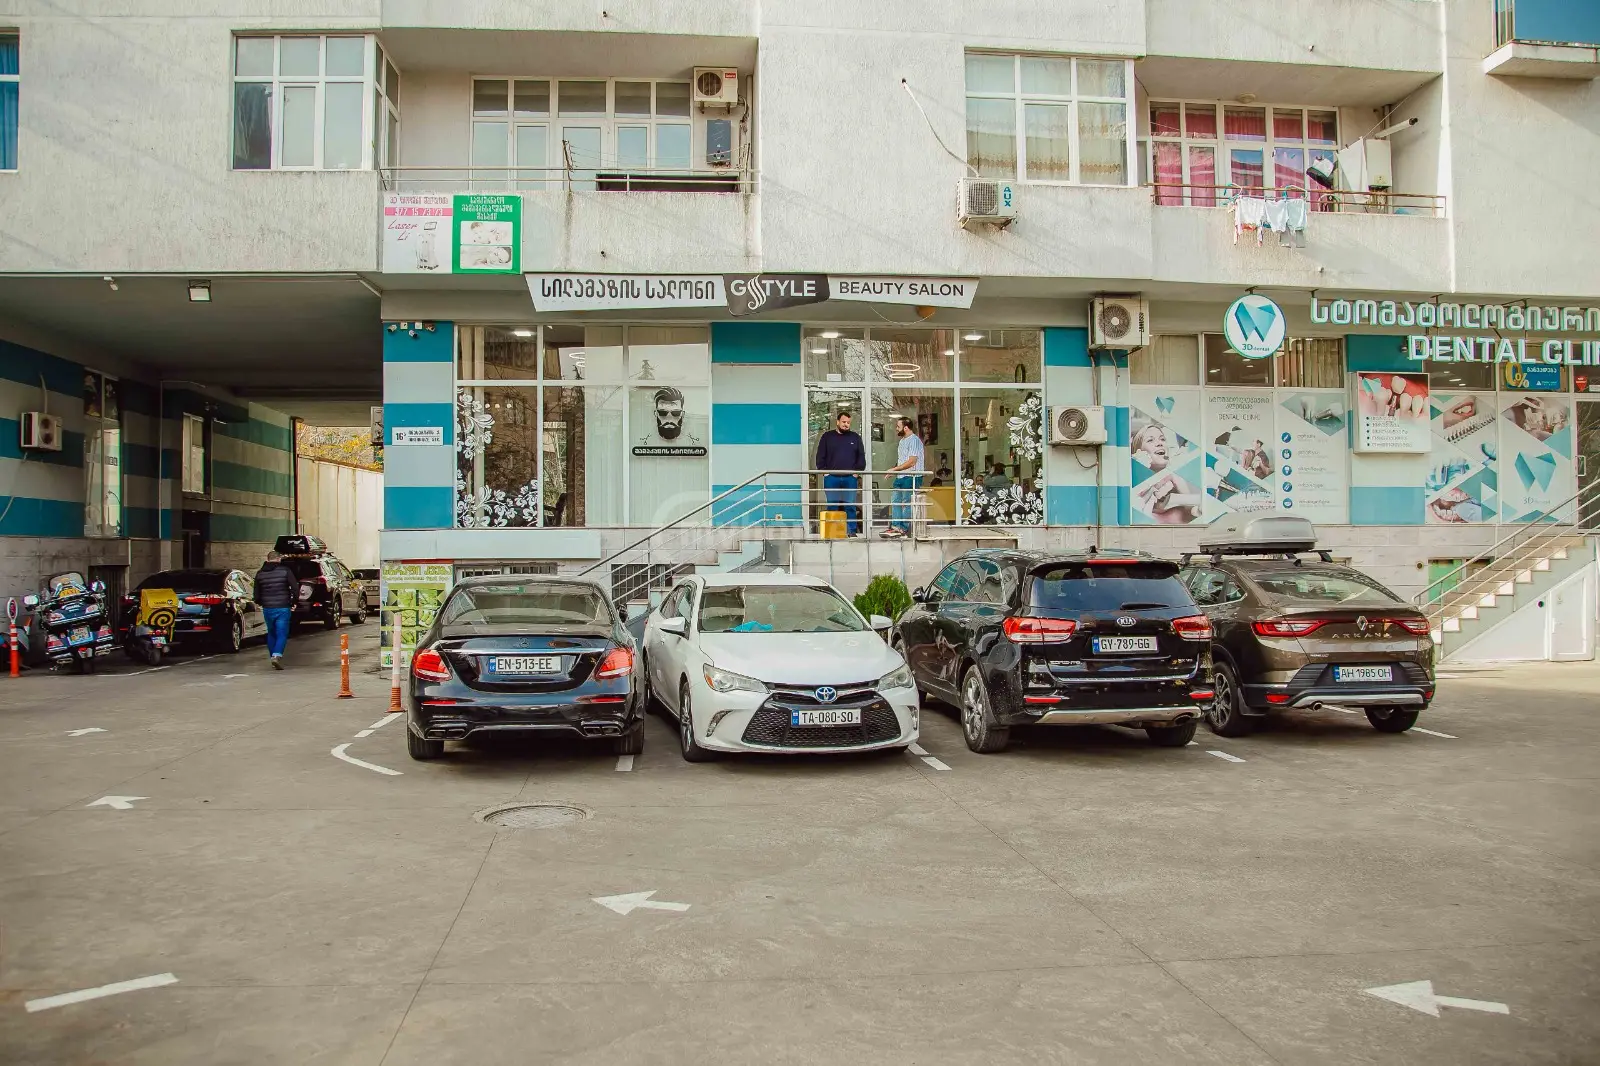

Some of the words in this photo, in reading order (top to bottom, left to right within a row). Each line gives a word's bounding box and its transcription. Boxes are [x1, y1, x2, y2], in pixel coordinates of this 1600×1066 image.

[1003, 186, 1011, 207] AUX
[541, 278, 640, 299] სილამაზის
[645, 279, 715, 300] სალონი
[839, 281, 904, 296] BEAUTY
[908, 283, 964, 297] SALON
[1310, 297, 1600, 331] სტომატოლოგიური
[1407, 335, 1537, 364] DENTAL
[1120, 617, 1135, 626] KIA
[1101, 638, 1150, 650] GY-789-GG
[497, 657, 552, 670] EN-513-EE
[1341, 669, 1354, 678] AH
[801, 711, 853, 723] TA-080-SO
